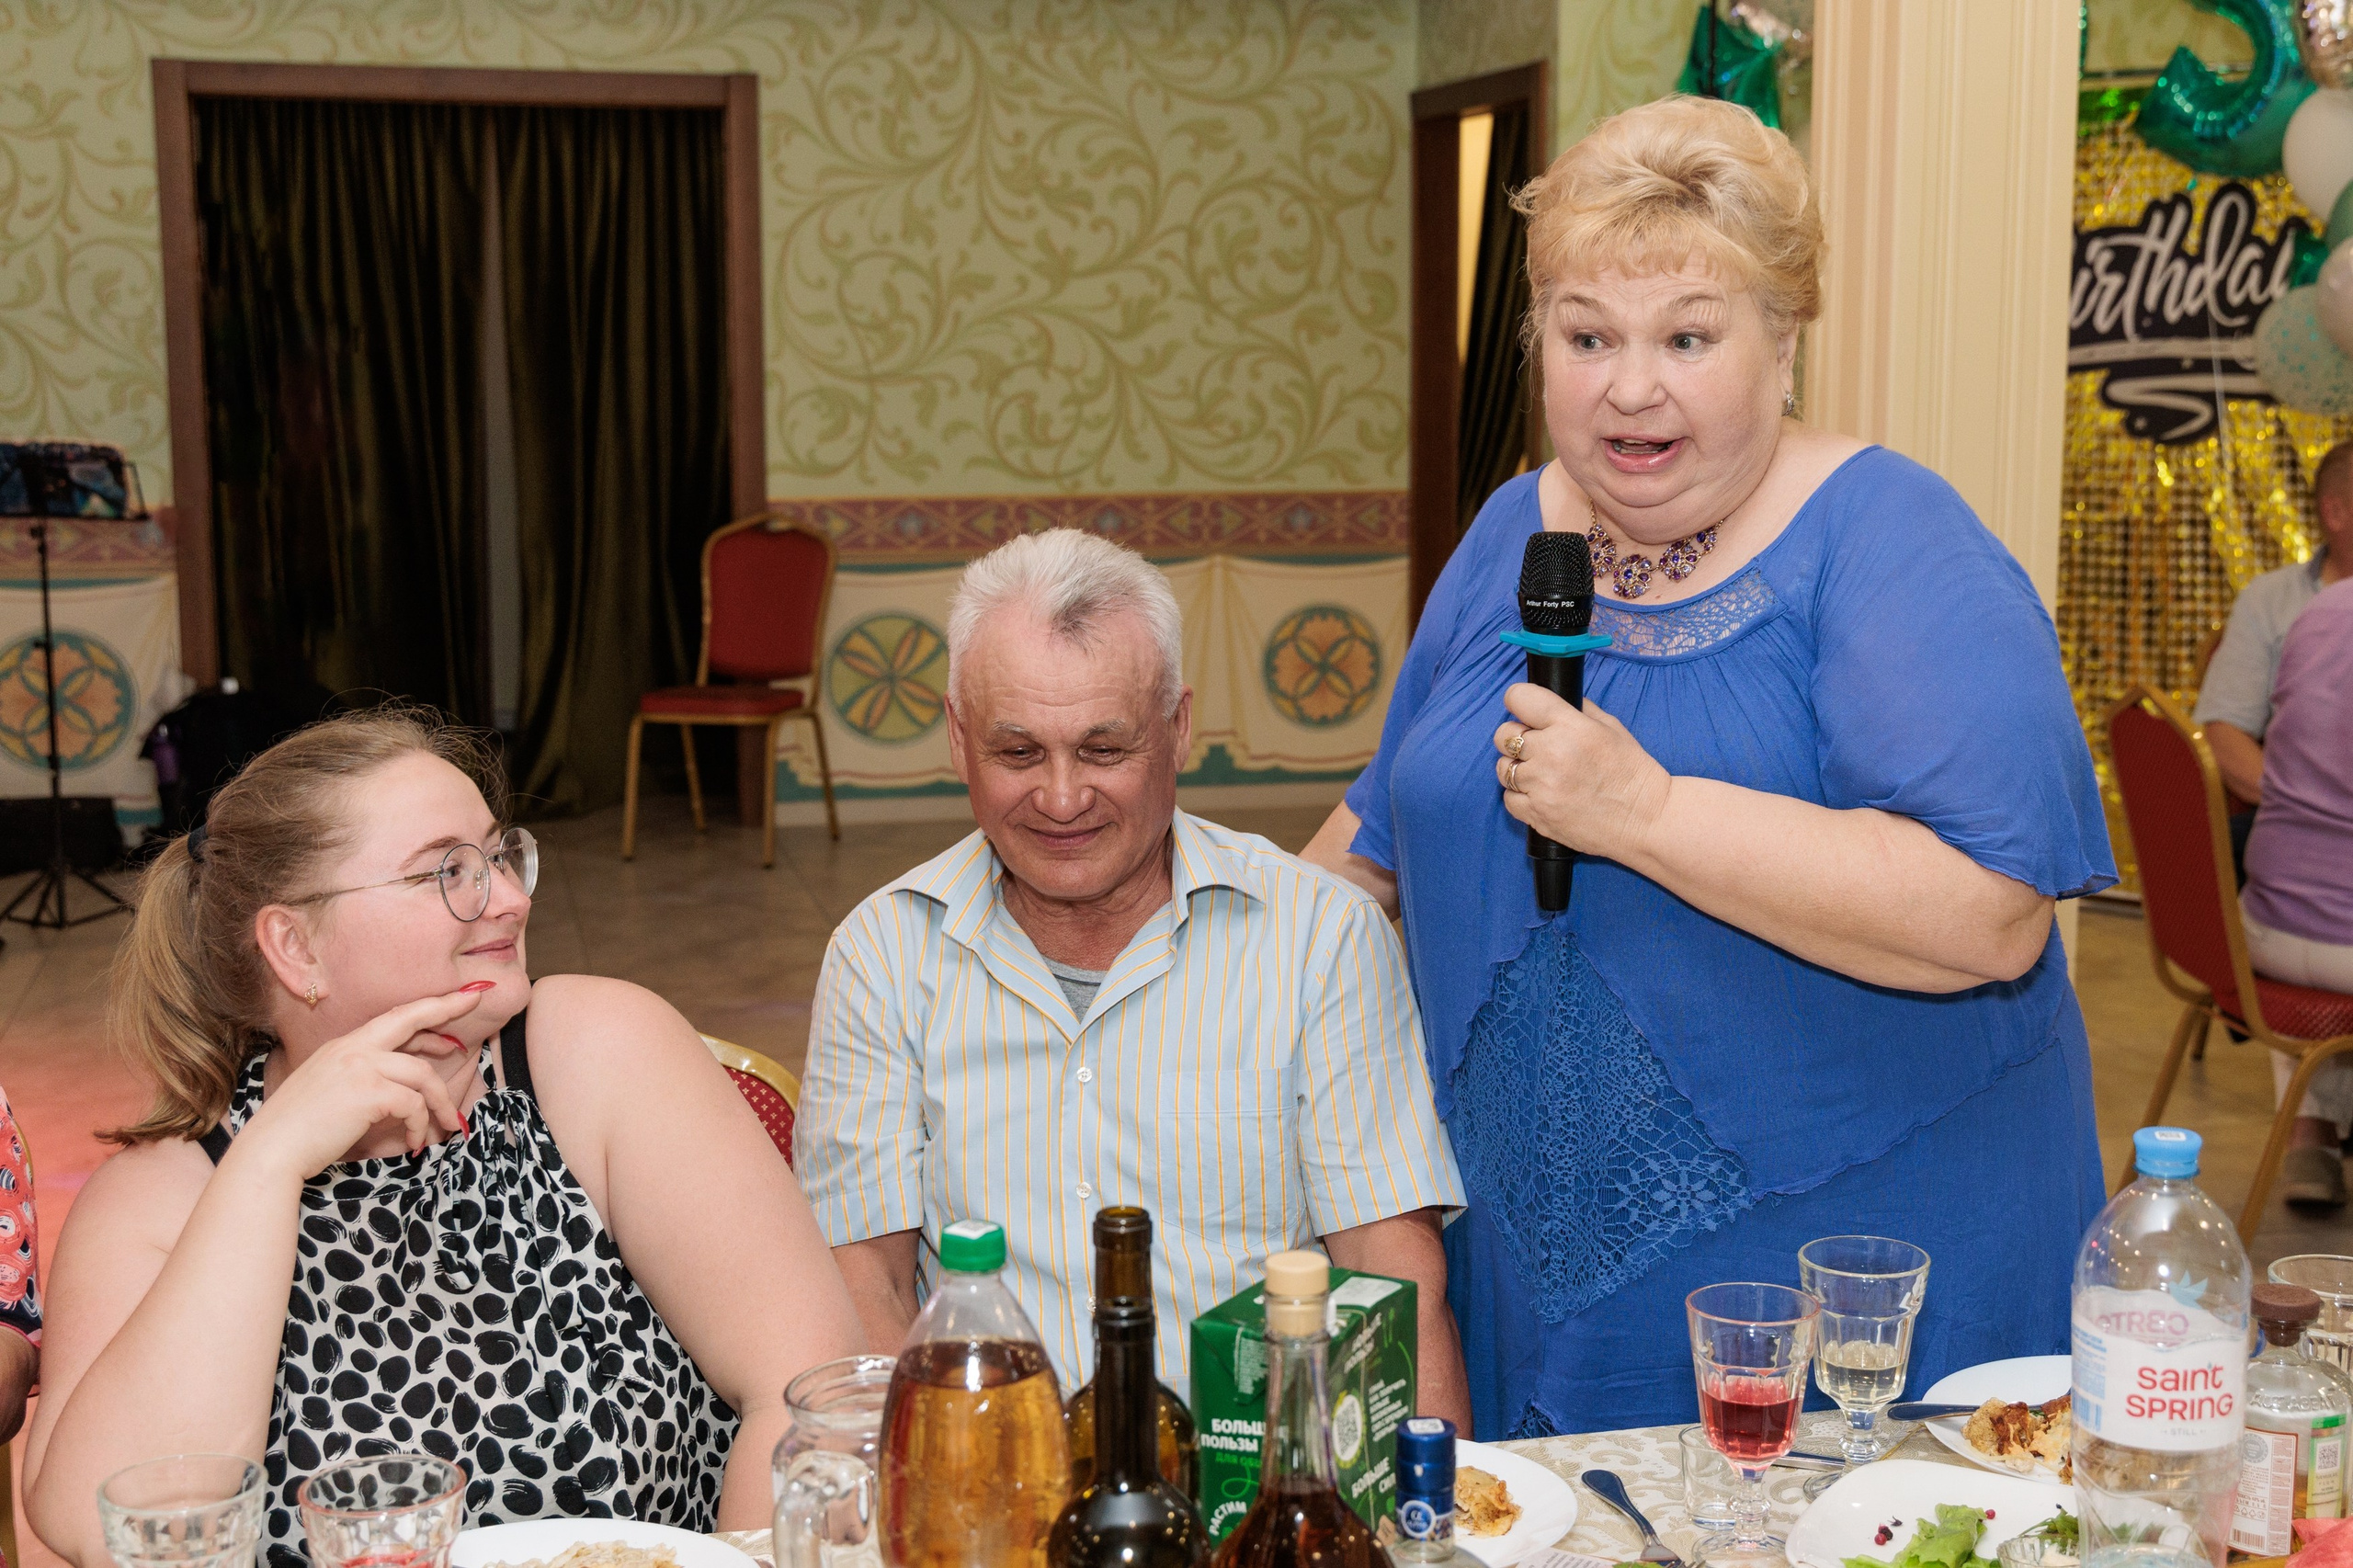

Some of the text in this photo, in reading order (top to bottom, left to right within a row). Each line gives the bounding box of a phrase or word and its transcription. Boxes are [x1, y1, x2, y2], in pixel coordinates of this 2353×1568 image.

[1543, 600, 1559, 608] Forty
[1211, 1418, 1267, 1437] БОЛЬШ
[1200, 1433, 1259, 1453] ПОЛЬЗЫ
[1209, 1500, 1247, 1537] РАСТИМ
